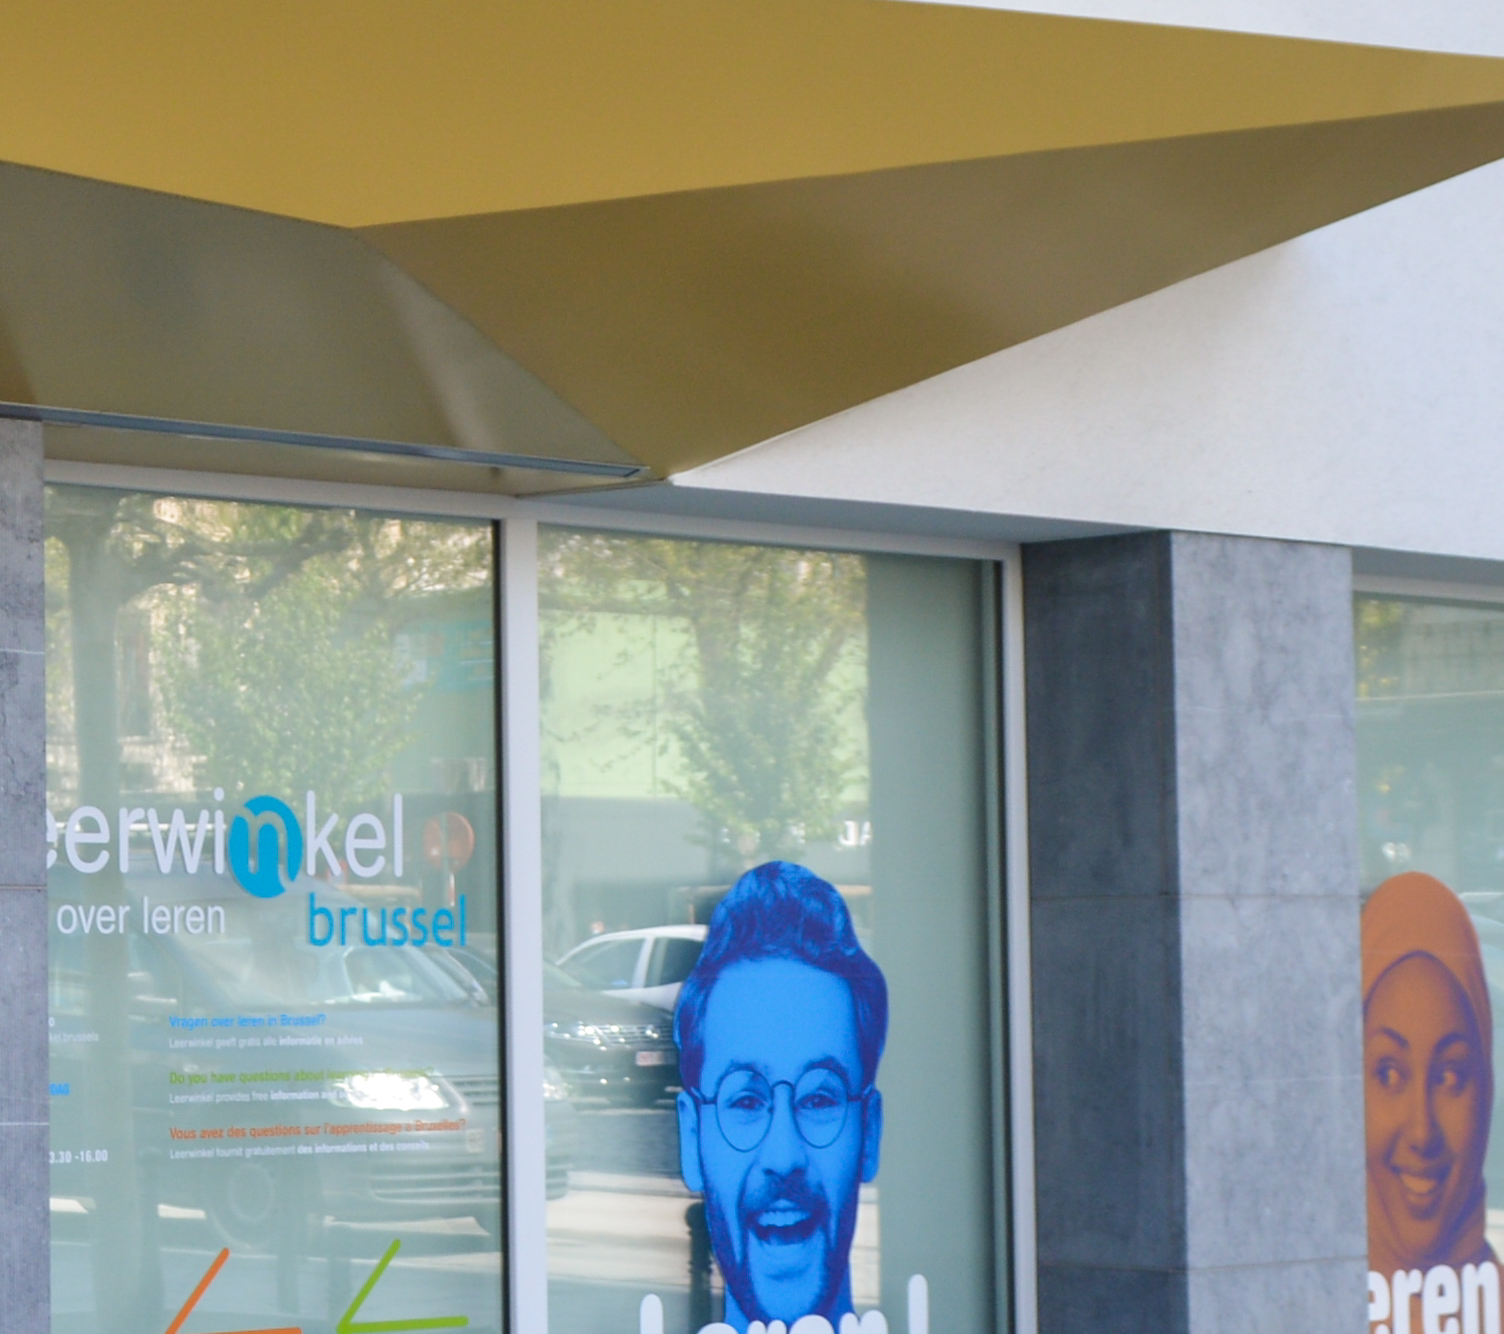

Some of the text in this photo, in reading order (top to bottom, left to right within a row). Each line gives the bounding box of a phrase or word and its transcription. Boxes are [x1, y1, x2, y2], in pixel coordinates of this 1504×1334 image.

[45, 788, 403, 892] erwinkel
[56, 893, 467, 947] over leren brussel
[169, 1016, 208, 1030] Vragen
[211, 1017, 234, 1027] over
[238, 1015, 265, 1027] leren
[280, 1013, 326, 1027] Brussel?
[169, 1037, 214, 1049] Leerwinkel
[170, 1072, 185, 1084] Do
[188, 1073, 207, 1086] you
[211, 1070, 235, 1083] have
[239, 1070, 290, 1084] questions
[294, 1068, 323, 1081] about
[170, 1127, 196, 1140] Vous
[200, 1127, 224, 1139] avez
[227, 1126, 246, 1138] des
[250, 1124, 301, 1139] questions
[304, 1125, 321, 1136] sur
[324, 1121, 402, 1135] l'apprentissage
[170, 1148, 214, 1160] Leerwinkel
[297, 1144, 313, 1155] des
[315, 1143, 367, 1154] informations
